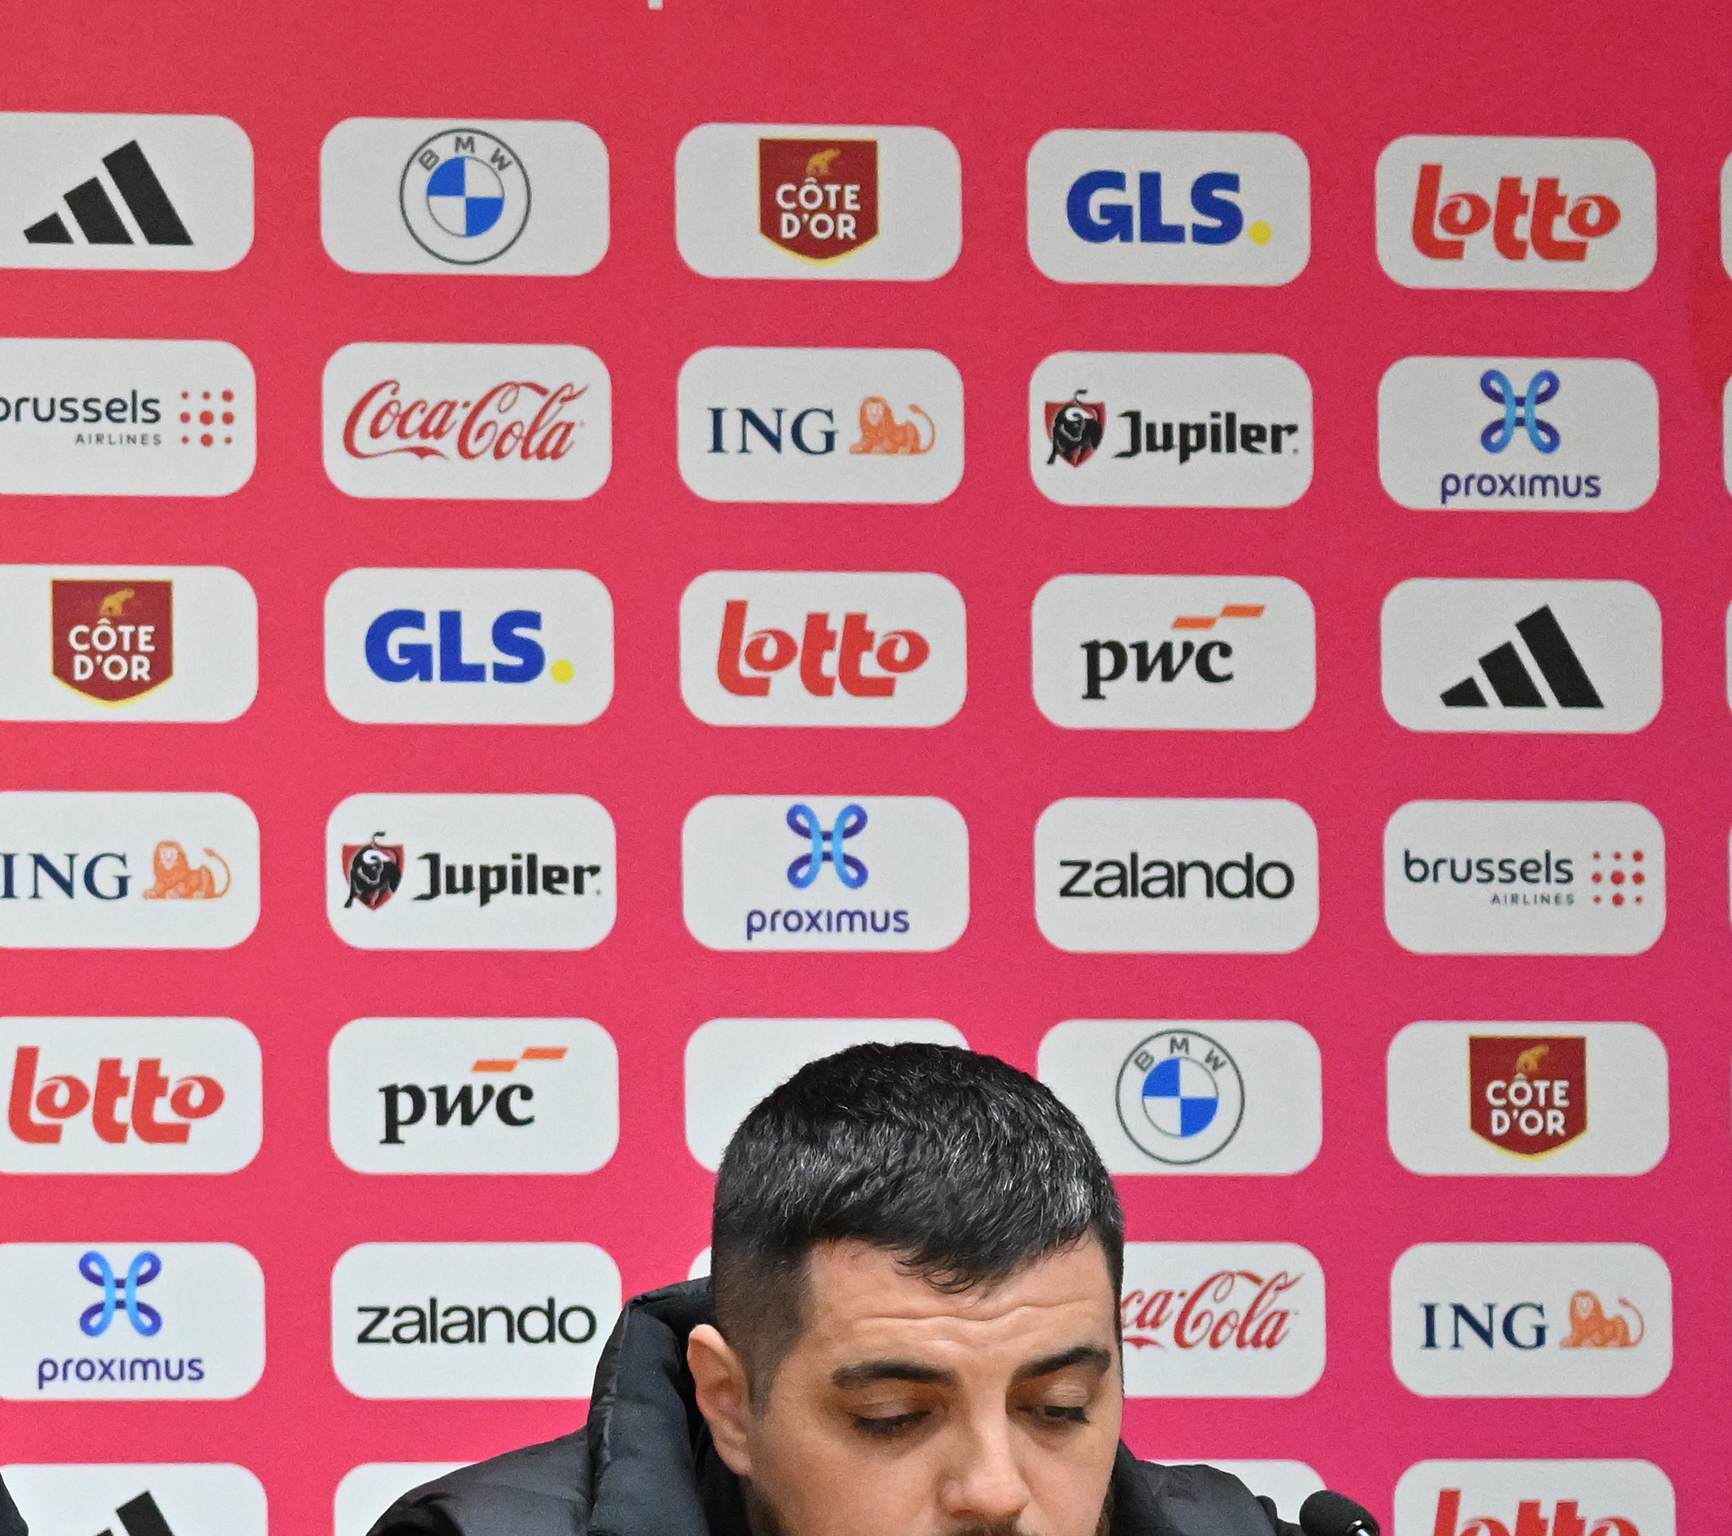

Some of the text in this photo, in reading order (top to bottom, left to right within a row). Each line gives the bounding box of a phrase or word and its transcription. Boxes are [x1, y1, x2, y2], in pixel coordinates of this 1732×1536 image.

[414, 130, 516, 173] BMW
[775, 176, 861, 211] CÔTE
[74, 432, 162, 447] AIRLINES
[342, 379, 588, 462] Coca-Cola
[706, 406, 839, 456] ING
[1113, 409, 1299, 465] Jupiler
[1440, 473, 1602, 505] proximus
[68, 618, 156, 653] CÔTE
[1080, 639, 1234, 701] pwc
[412, 851, 602, 908] Jupiler
[1058, 851, 1295, 900] zalando
[1403, 847, 1575, 886] brussels
[1490, 892, 1575, 906] AIRLINES
[746, 909, 910, 941] proximus
[1130, 1031, 1229, 1073] BMW
[1486, 1073, 1570, 1107] CÔTE
[378, 1083, 535, 1145] pwc
[356, 1295, 598, 1346] zalando
[1420, 1301, 1549, 1351] ING
[37, 1357, 205, 1391] proximus
